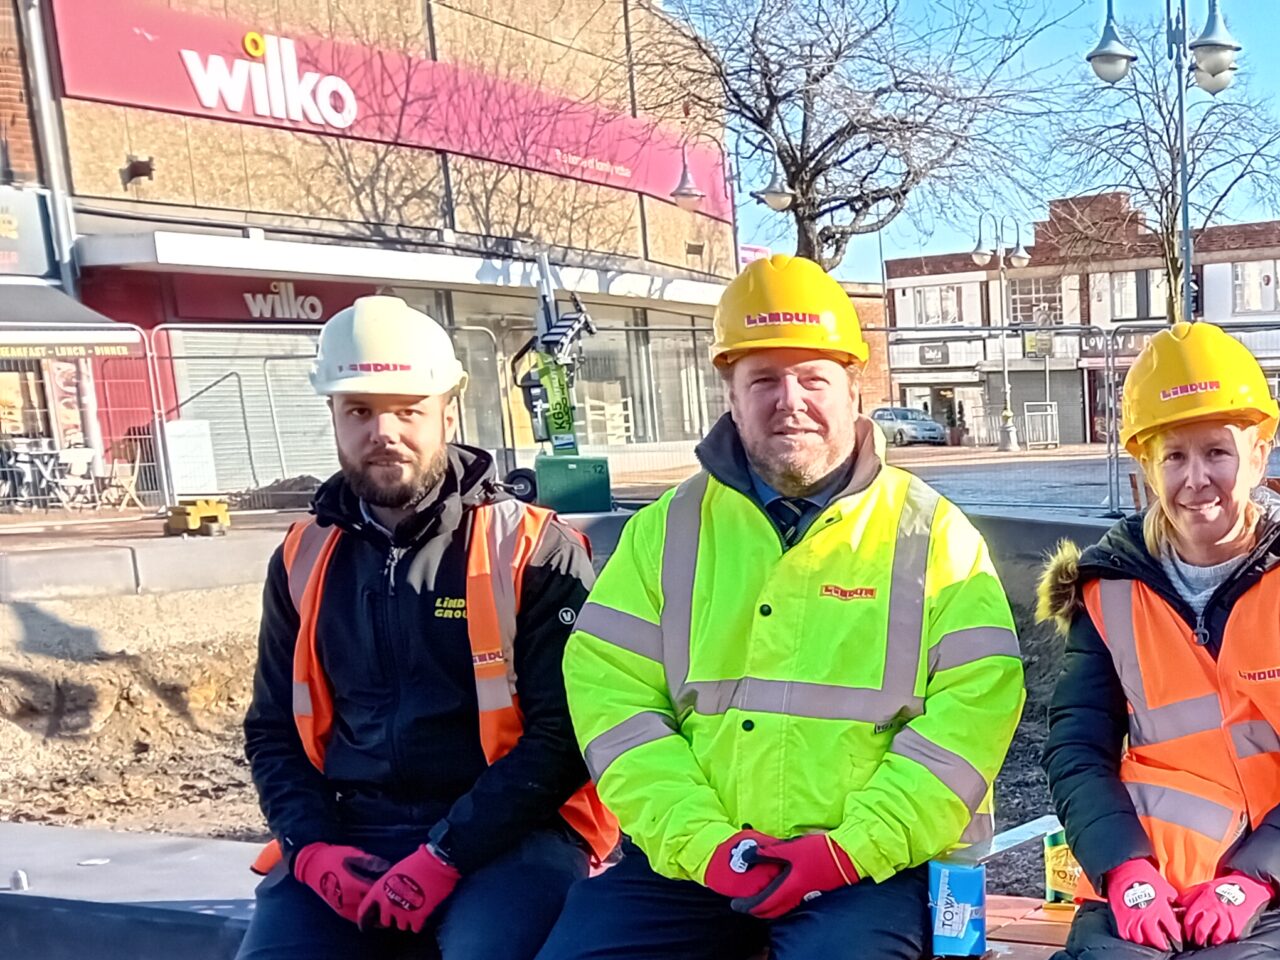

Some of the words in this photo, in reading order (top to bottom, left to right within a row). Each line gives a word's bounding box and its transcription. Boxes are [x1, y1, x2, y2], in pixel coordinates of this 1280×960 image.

[179, 31, 357, 128] wilko
[243, 282, 323, 320] wilko
[434, 609, 468, 619] GROU
